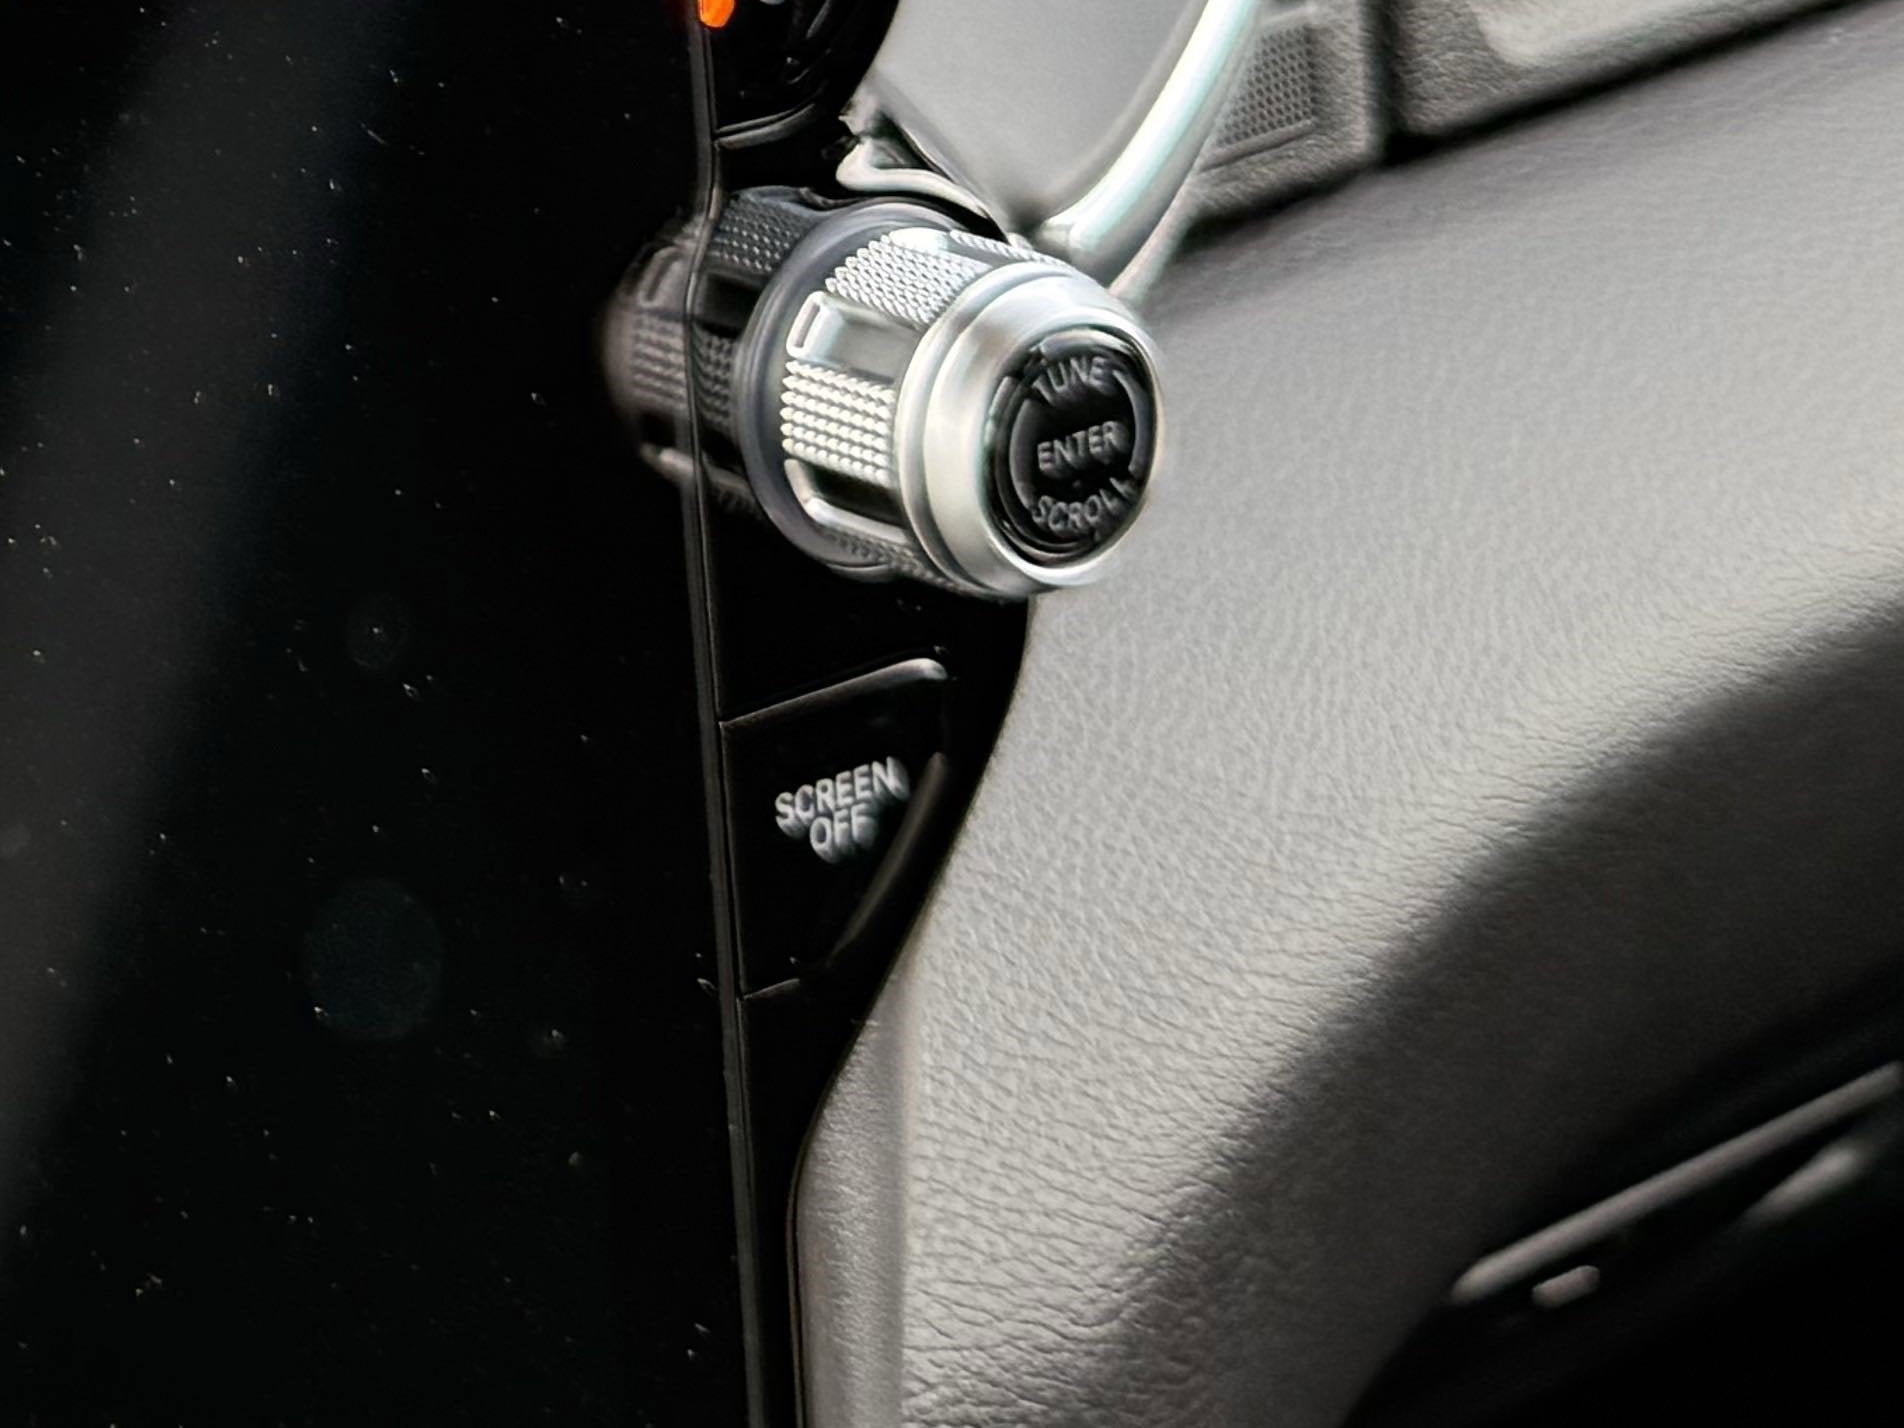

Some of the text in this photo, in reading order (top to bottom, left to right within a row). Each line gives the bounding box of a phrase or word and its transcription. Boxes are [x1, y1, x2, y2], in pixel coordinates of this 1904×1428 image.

[1032, 354, 1116, 407] TUNE
[1037, 419, 1129, 479] ENTER
[774, 755, 911, 838] SCREEN
[809, 802, 880, 864] OFF
